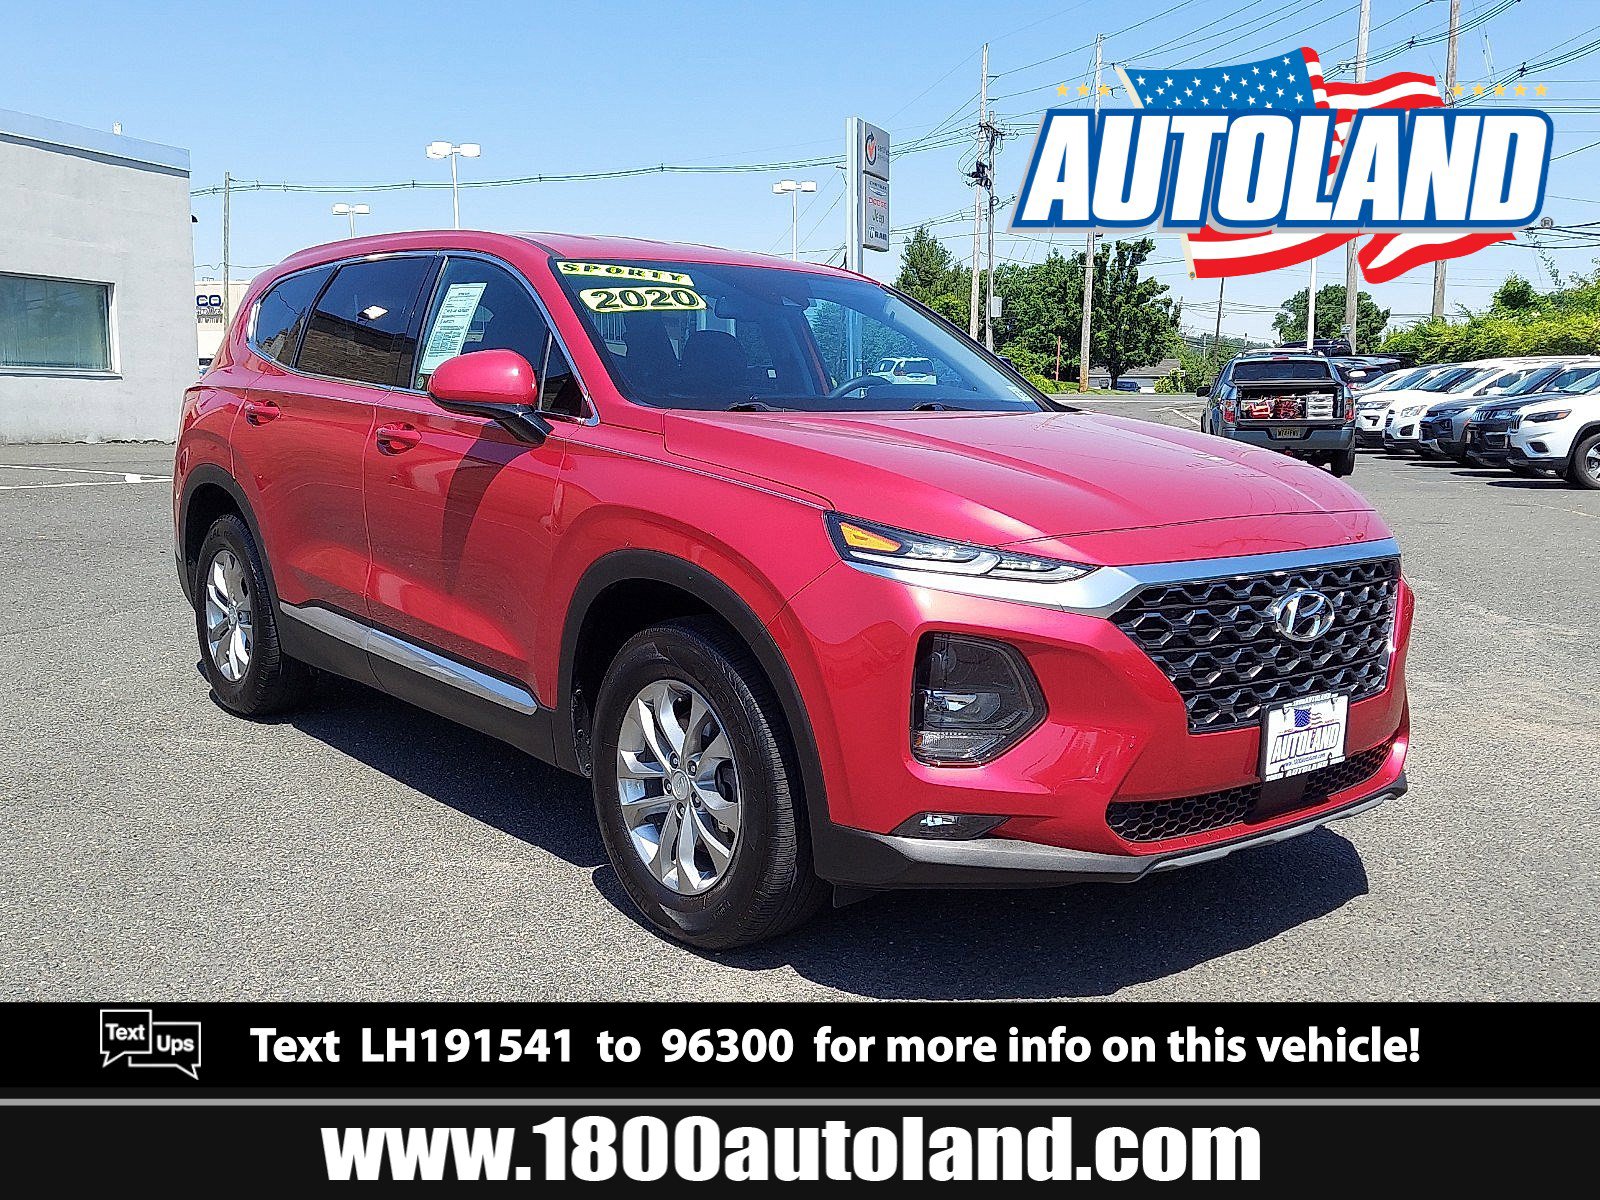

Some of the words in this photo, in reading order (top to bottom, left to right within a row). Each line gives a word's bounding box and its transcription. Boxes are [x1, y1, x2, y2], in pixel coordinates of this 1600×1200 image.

[562, 262, 686, 283] SPORTY
[590, 288, 700, 310] 2020
[1269, 721, 1341, 765] AUTOLAND
